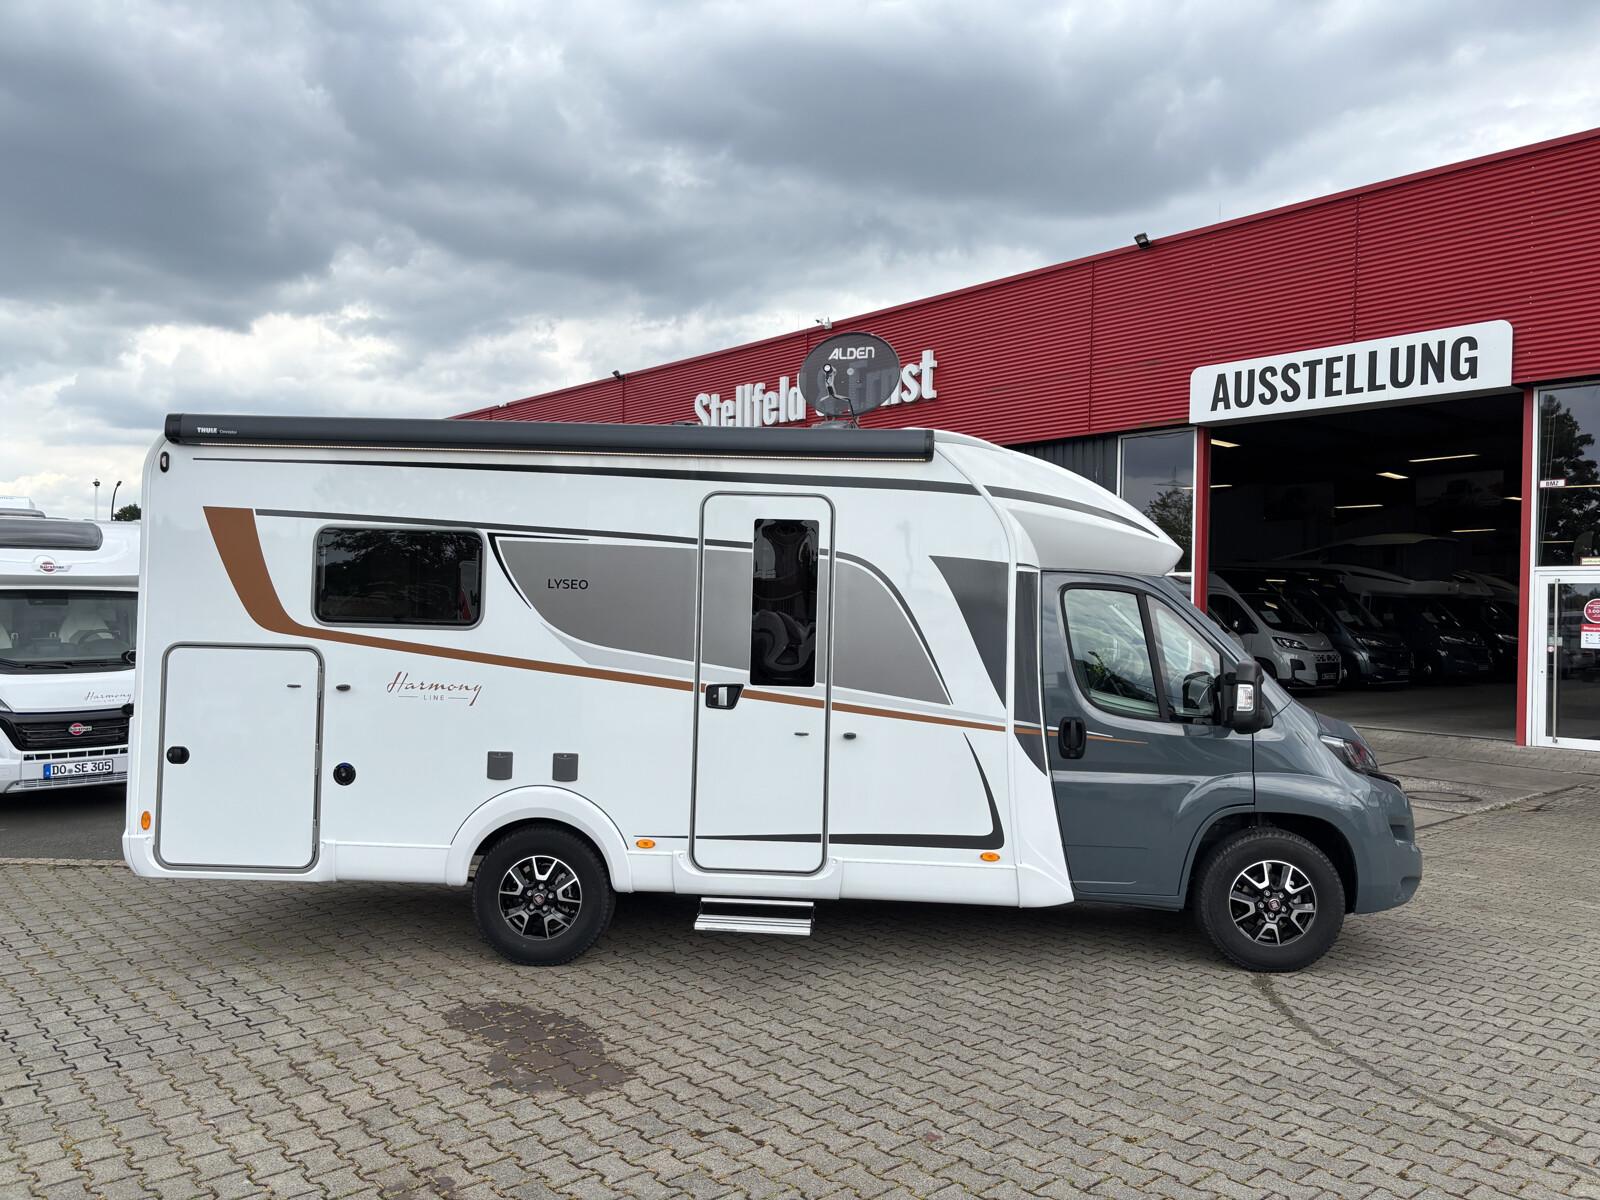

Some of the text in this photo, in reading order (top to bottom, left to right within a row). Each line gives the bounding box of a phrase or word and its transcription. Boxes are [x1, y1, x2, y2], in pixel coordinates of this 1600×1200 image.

[828, 346, 875, 360] ALDEN
[1210, 336, 1479, 412] AUSSTELLUNG
[694, 373, 807, 427] Stellfeld
[547, 578, 589, 590] LYSEO
[386, 671, 482, 706] Harmony
[52, 761, 111, 775] DO SE 305
